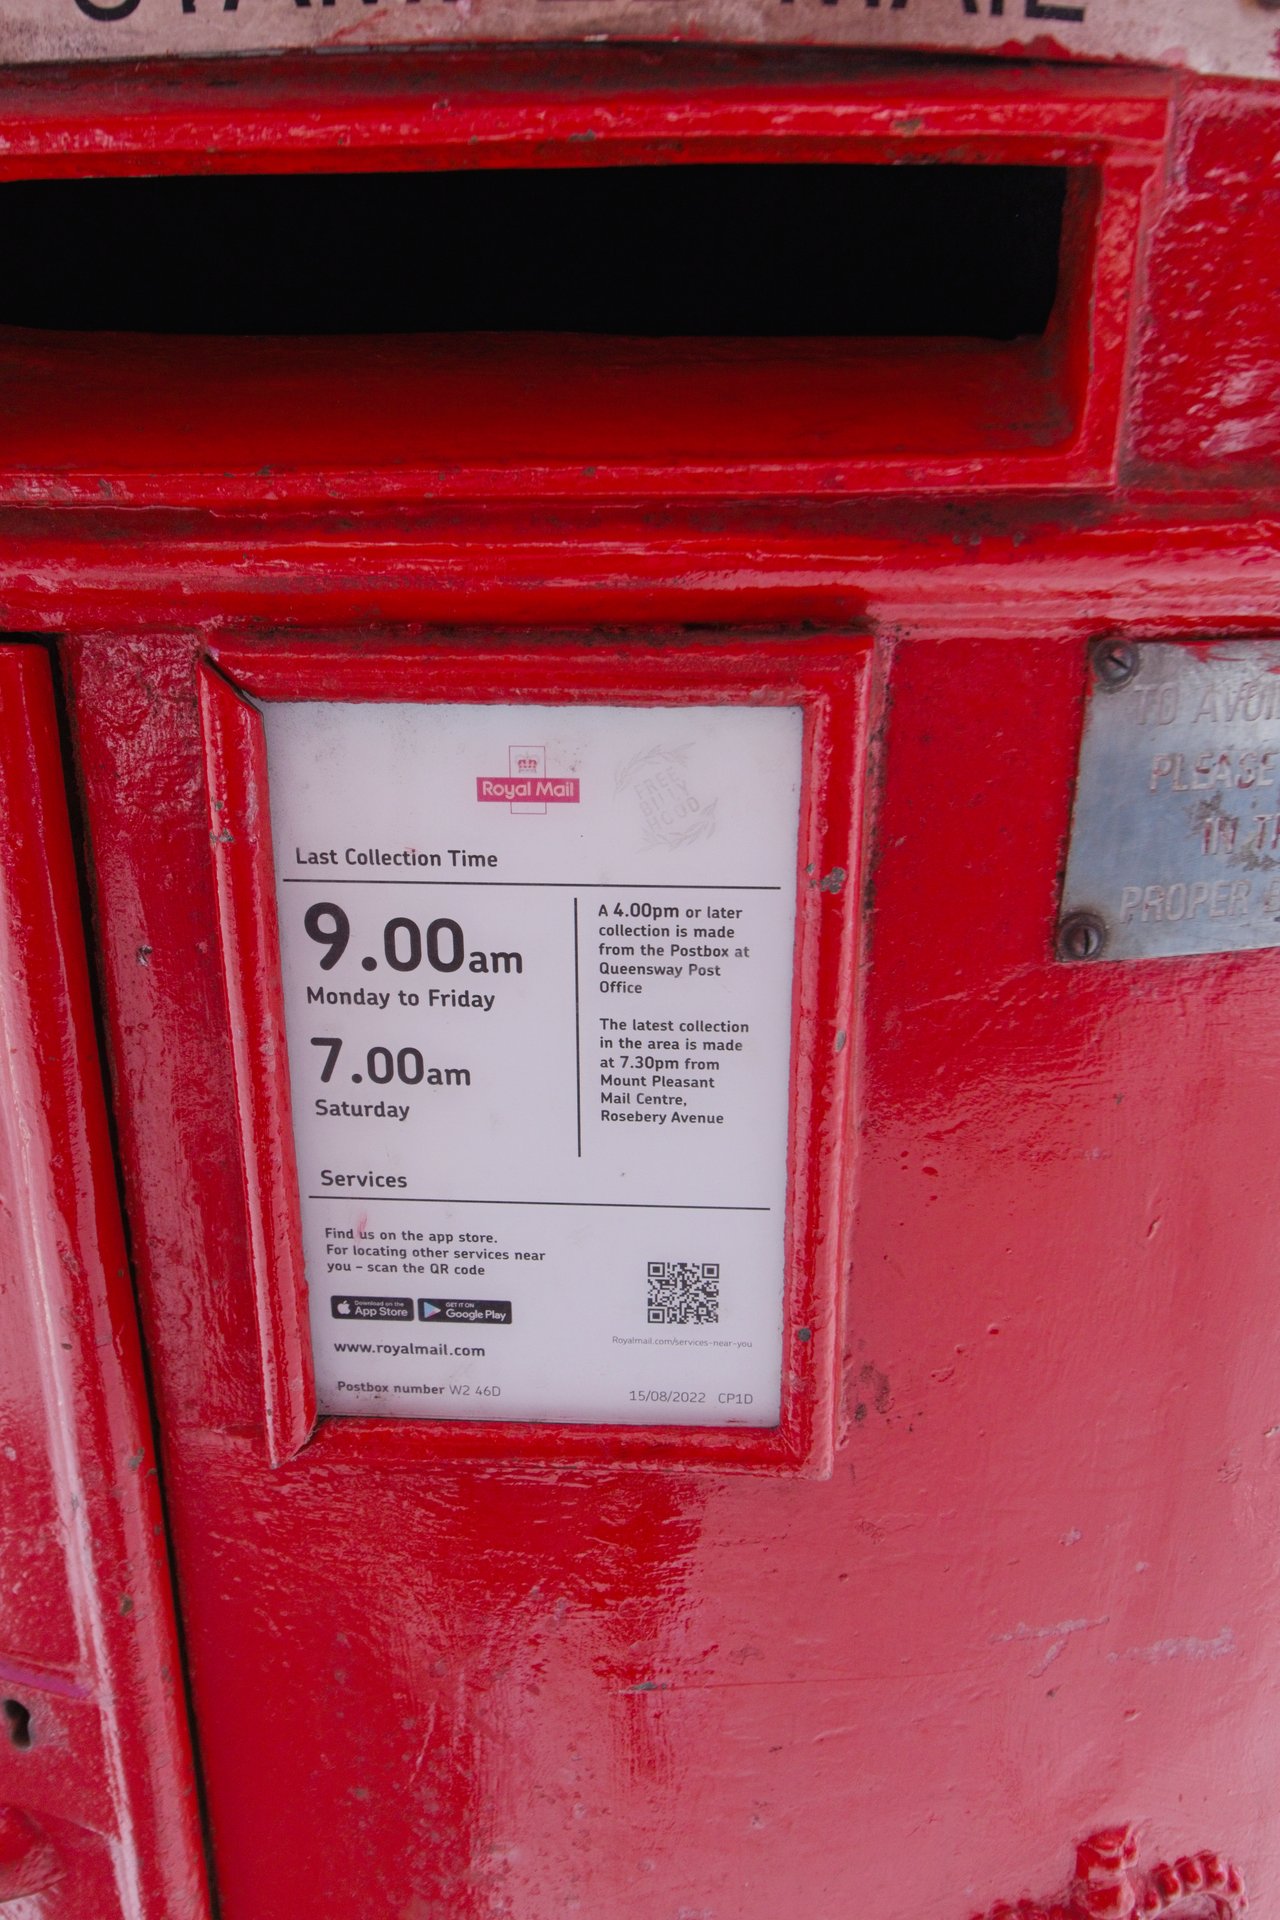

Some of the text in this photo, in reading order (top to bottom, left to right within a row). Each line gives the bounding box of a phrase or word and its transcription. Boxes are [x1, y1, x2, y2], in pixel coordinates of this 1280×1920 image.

[1133, 681, 1280, 726] TO AVOI
[1150, 751, 1280, 793] PLEASE
[482, 781, 573, 798] Royal Mail
[1202, 816, 1239, 855] IN
[296, 848, 497, 867] Last Collection Time
[1119, 878, 1252, 925] PROPER
[598, 903, 742, 920] A 4.00pm or later
[304, 902, 522, 973] 9.00am
[599, 924, 734, 938] collection is made
[599, 943, 749, 957] from the Postbox at
[599, 962, 720, 978] Queensway Post
[600, 981, 642, 993] Office
[307, 986, 495, 1011] Monday to Friday
[600, 1018, 748, 1032] The latest collection
[600, 1037, 742, 1051] in the area is made
[310, 1037, 470, 1086] 7.00am
[600, 1056, 719, 1071] at 7.30pm from
[601, 1074, 714, 1088] Mount Pleasant
[601, 1092, 686, 1106] Mail Centre,
[315, 1099, 409, 1121] Saturday
[601, 1110, 723, 1125] Rosebery Avenue
[321, 1170, 407, 1188] Services
[325, 1228, 497, 1244] Find us on the app store.
[327, 1244, 545, 1260] For locating other services near
[327, 1263, 351, 1273] you
[367, 1264, 397, 1272] scan
[403, 1263, 424, 1273] the
[430, 1263, 448, 1274] QR
[455, 1265, 485, 1275] code
[355, 1307, 408, 1317] App Store
[446, 1309, 506, 1321] Google Play
[334, 1343, 485, 1356] www.royalmail.com
[612, 1336, 752, 1348] Royalmail.com/services-near-you
[337, 1381, 500, 1396] Postbox number W2 46D
[630, 1391, 753, 1404] 15/08/2022 CP1D
